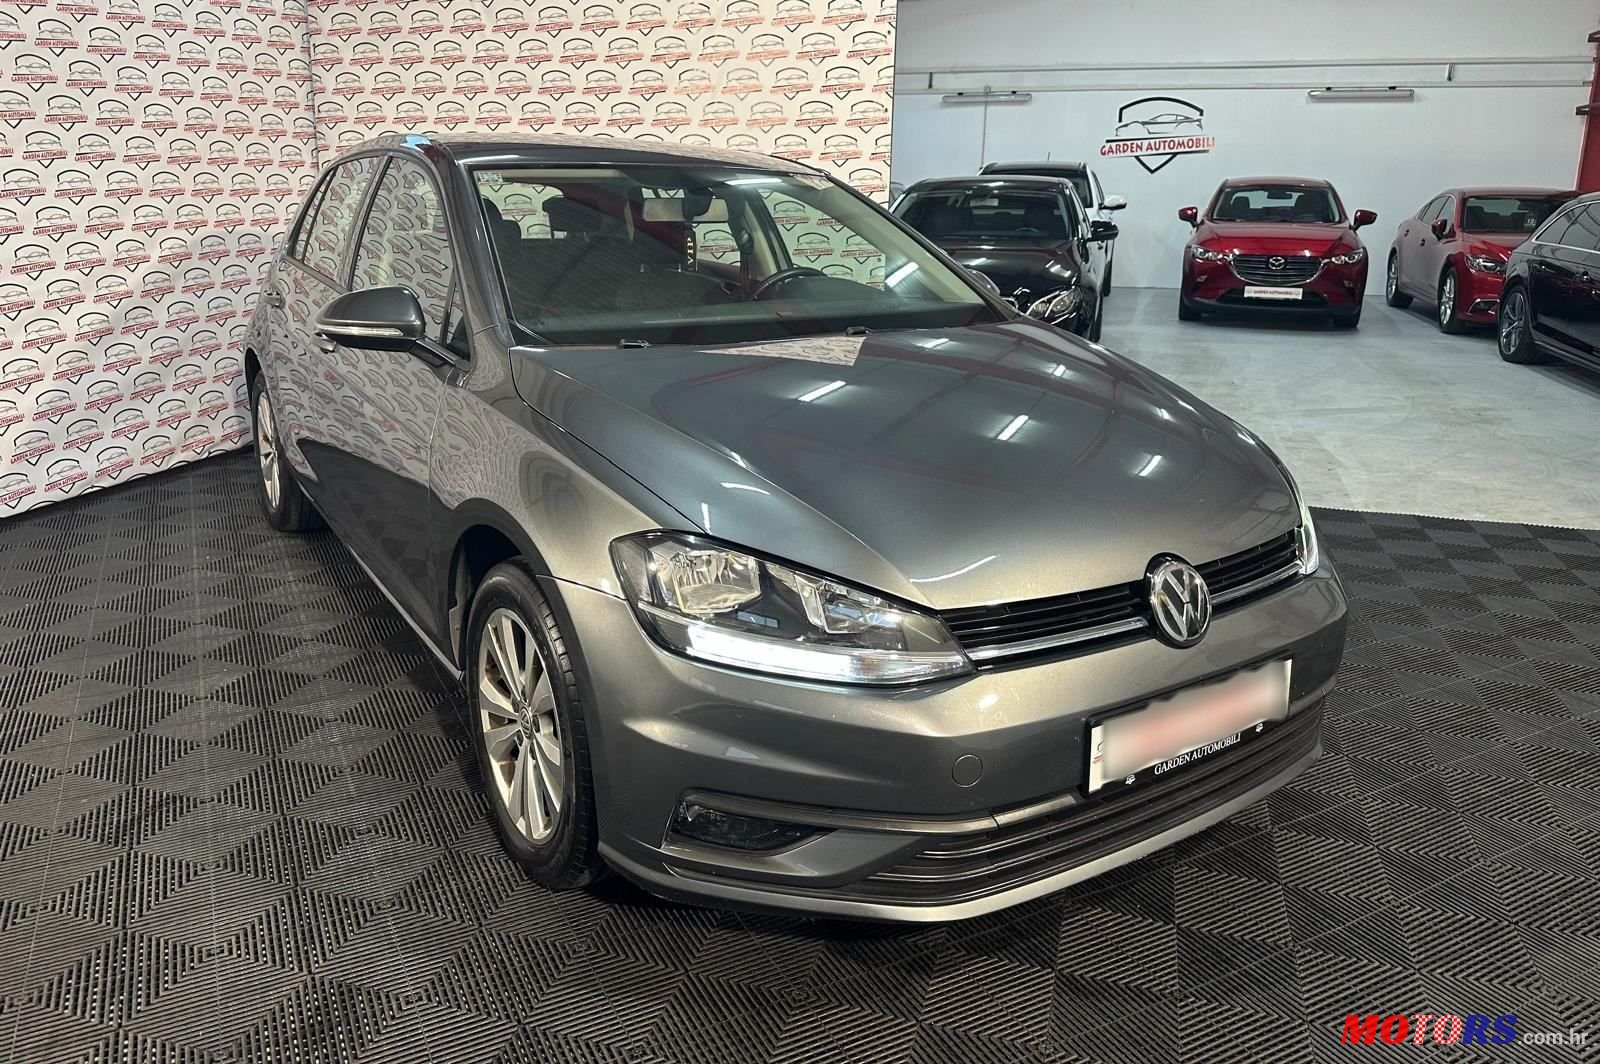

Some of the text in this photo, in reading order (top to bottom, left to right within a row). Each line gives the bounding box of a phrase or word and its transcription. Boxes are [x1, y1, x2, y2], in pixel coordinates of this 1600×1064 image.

[1100, 137, 1215, 156] GARDEN AUTOMOBILI
[1154, 732, 1241, 775] GARDEN AUTOMOBILI
